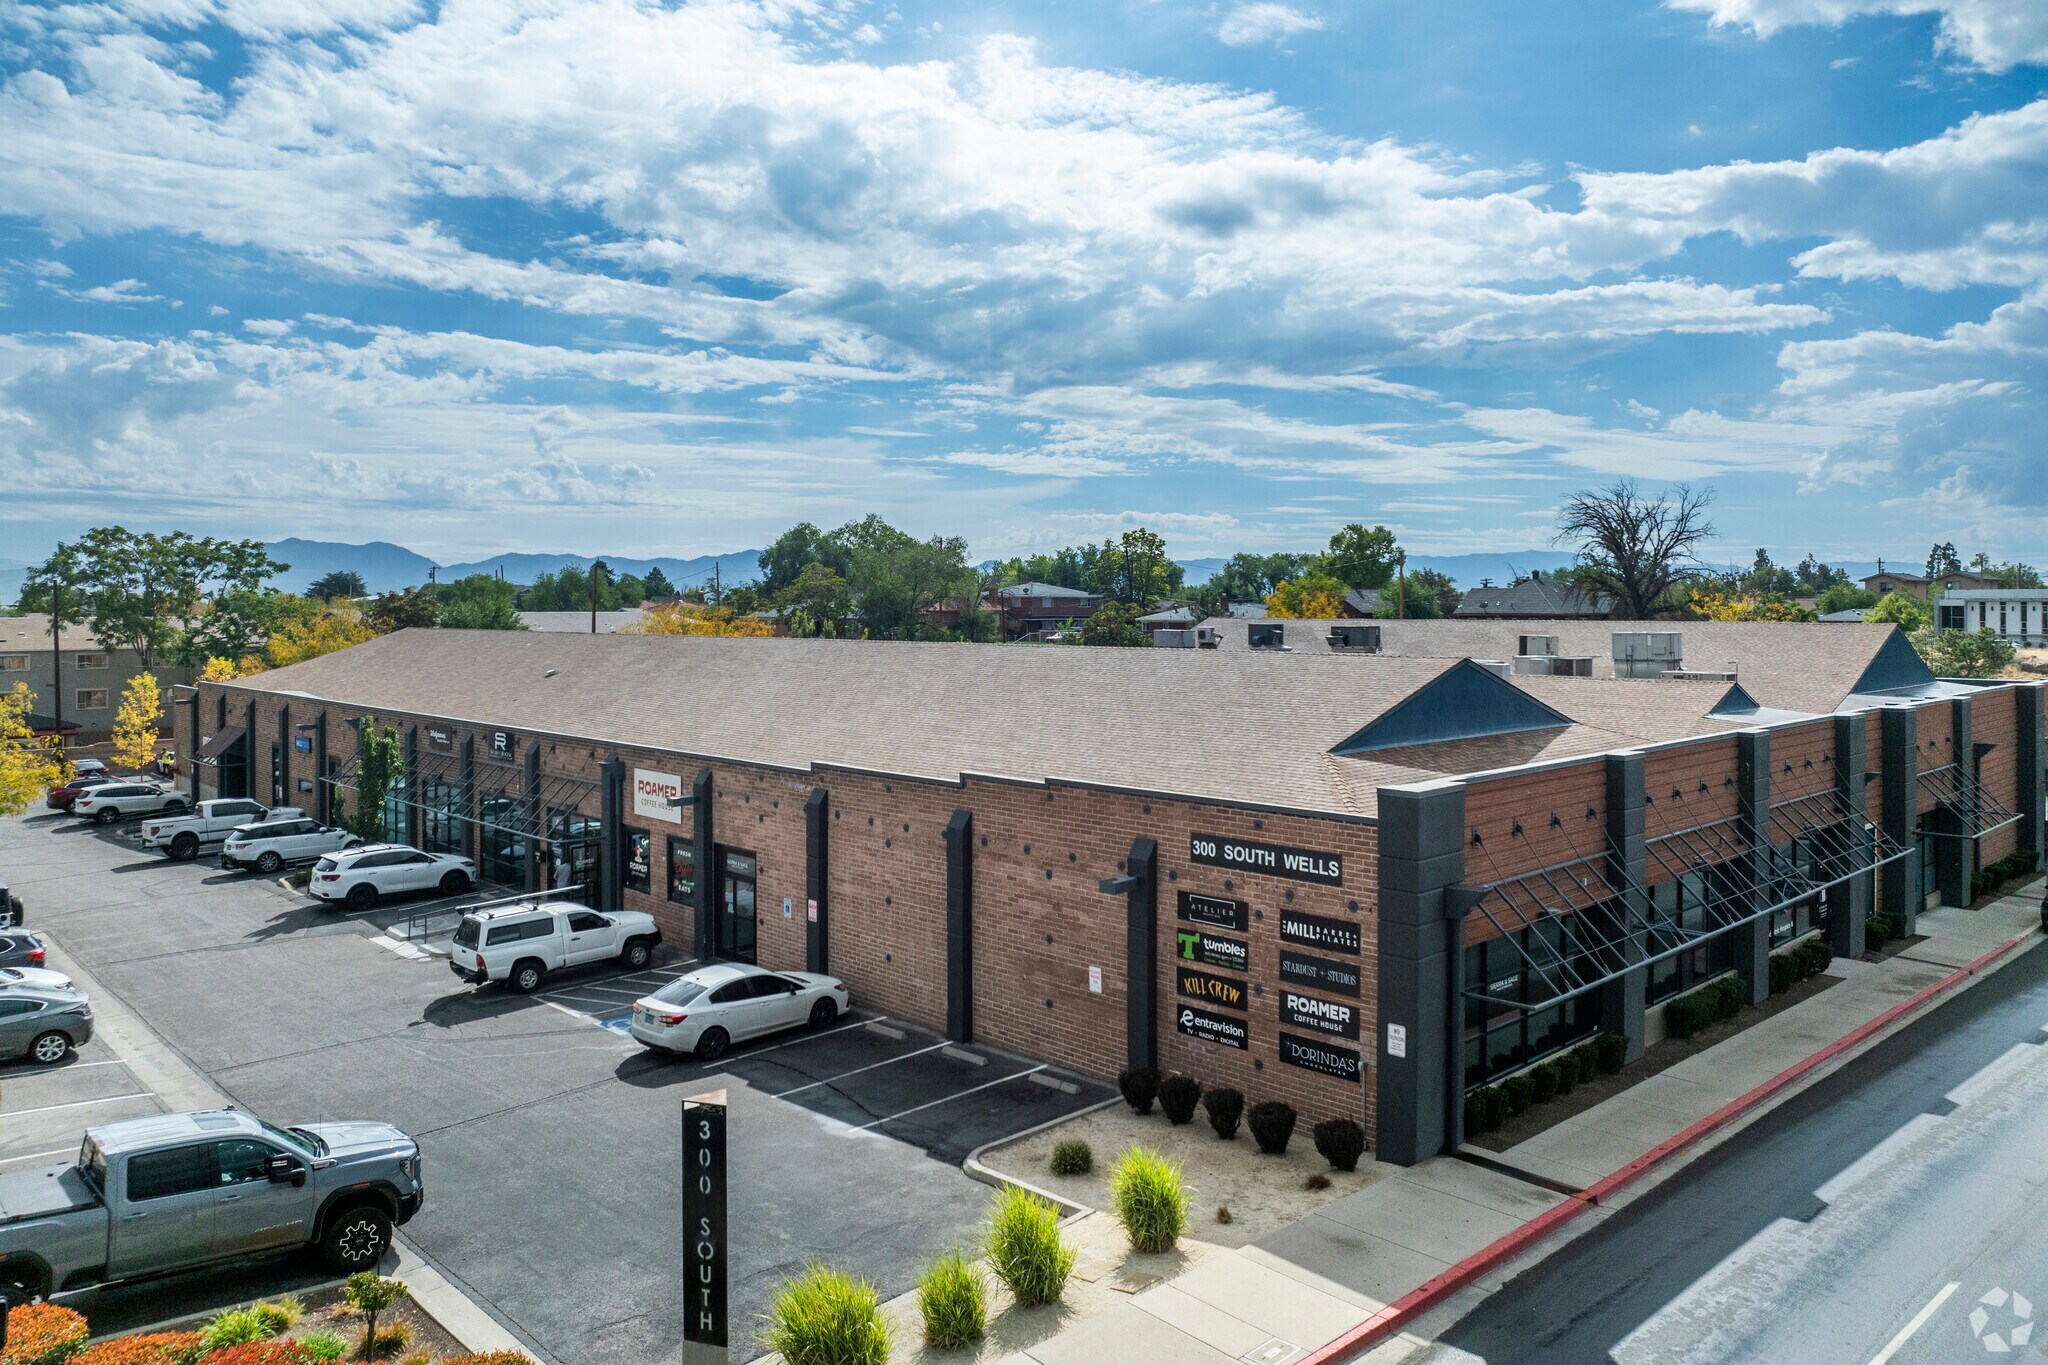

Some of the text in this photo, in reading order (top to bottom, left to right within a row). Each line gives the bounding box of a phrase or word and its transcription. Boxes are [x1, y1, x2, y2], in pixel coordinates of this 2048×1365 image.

[638, 779, 677, 799] ROAMER
[641, 798, 657, 808] COFFEE
[629, 861, 648, 873] ROAMER
[1192, 840, 1340, 877] 300 SOUTH WELLS
[678, 884, 691, 894] EATS
[1191, 903, 1234, 917] ATELIER
[1286, 920, 1316, 940] MILL
[1203, 938, 1246, 958] tumbles
[1316, 933, 1358, 948] PILATES
[1282, 960, 1317, 978] STARDUST
[1327, 970, 1357, 986] STUDIOS
[1183, 977, 1241, 1004] KILL CREW
[1287, 994, 1350, 1024] ROAMER
[1194, 1017, 1244, 1038] entravision
[1293, 1013, 1343, 1033] COFFEE HOUSE
[1198, 1031, 1215, 1041] RADIO
[1220, 1037, 1240, 1048] DIGITAL
[1292, 1043, 1355, 1072] DORINDA'S
[699, 1120, 711, 1195] 300
[697, 1217, 714, 1331] SOUTH
